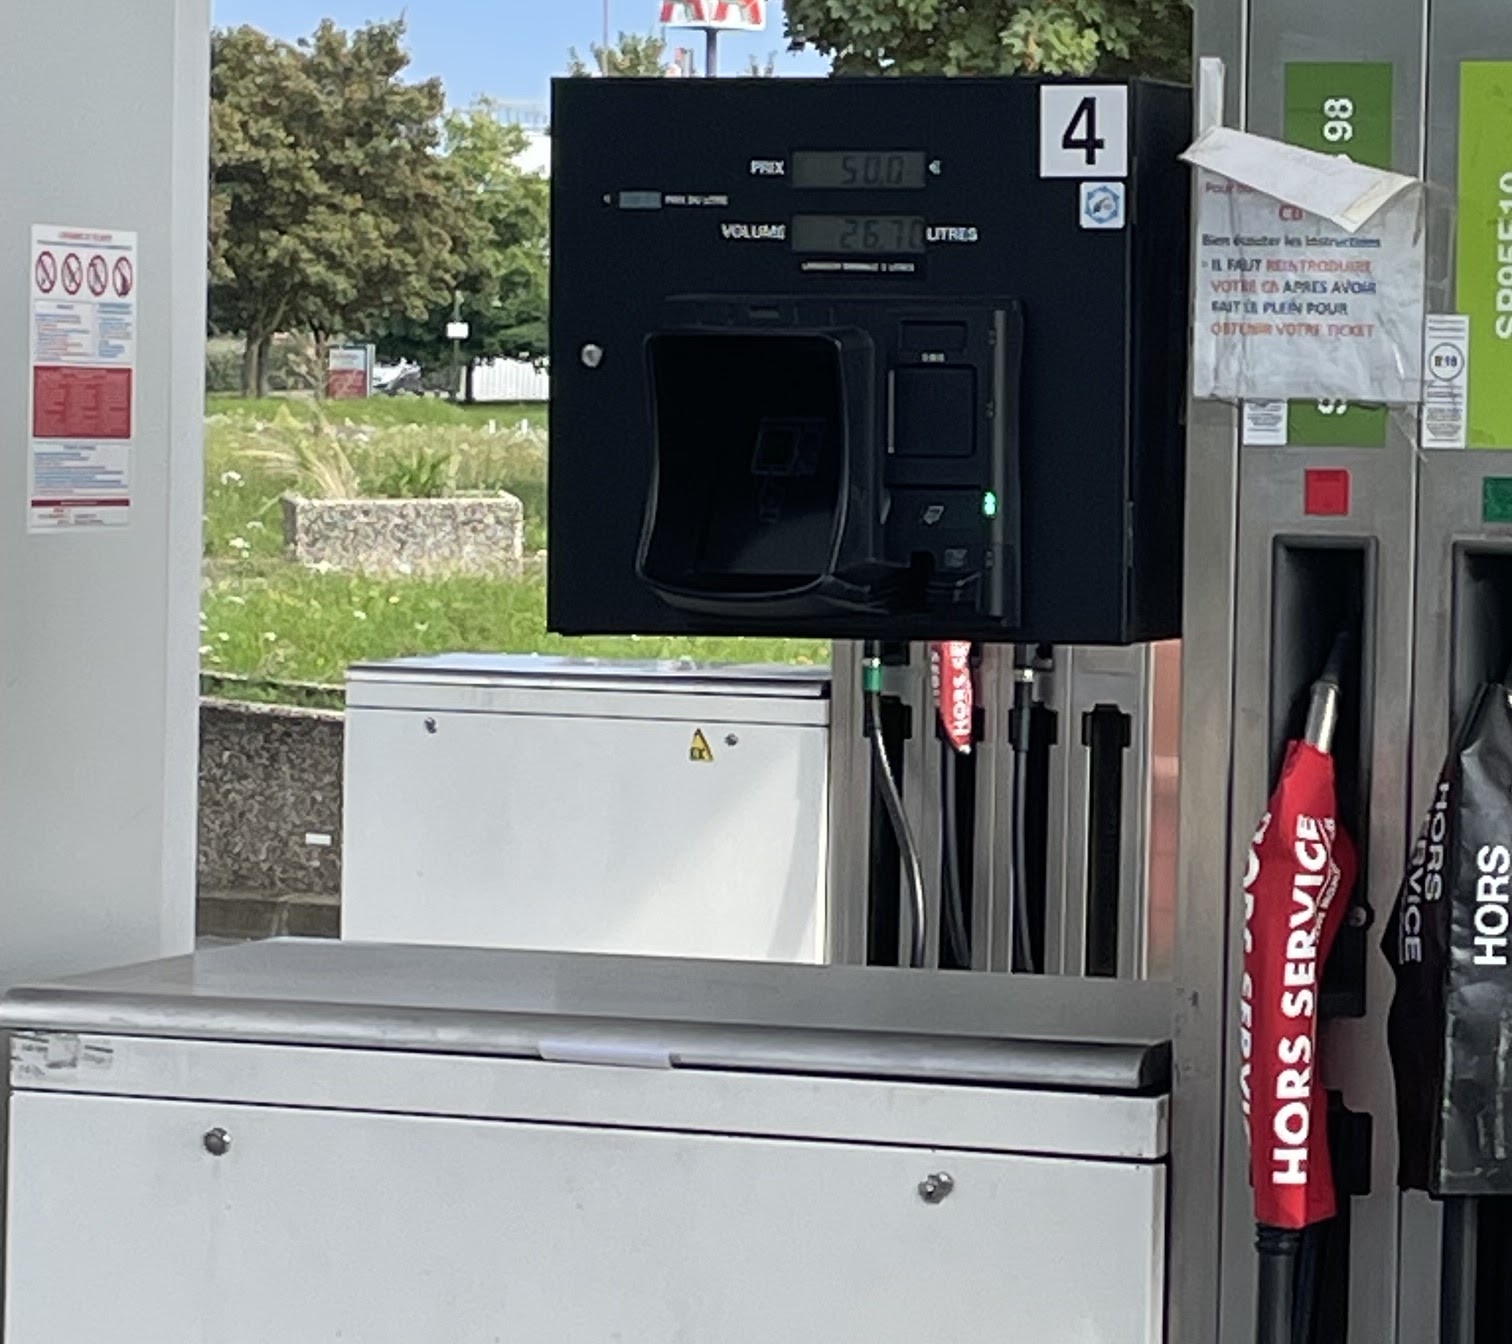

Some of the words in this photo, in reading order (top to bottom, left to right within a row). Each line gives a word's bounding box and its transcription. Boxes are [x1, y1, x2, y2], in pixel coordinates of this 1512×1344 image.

[1323, 97, 1353, 141] 98
[1062, 96, 1105, 166] 4
[750, 160, 785, 175] PRIX
[720, 224, 786, 240] VOLUME
[926, 227, 978, 242] LITRES
[1202, 234, 1230, 246] Bien
[1284, 235, 1302, 246] les
[1211, 260, 1223, 271] IL
[1227, 259, 1262, 271] FAUT
[1266, 260, 1372, 273] REINTRODUIRE
[1211, 280, 1257, 293] VOTRE
[1282, 281, 1327, 293] APRES
[1331, 281, 1377, 294] AVOIR
[1211, 301, 1241, 312] FAIT
[1244, 302, 1258, 314] LE
[1263, 301, 1302, 314] PLEIN
[1306, 302, 1348, 315] POUR
[1211, 323, 1273, 336] OBTENIR
[1276, 323, 1320, 337] VOTRE
[1327, 324, 1374, 337] TICKET
[1425, 782, 1450, 901] HORS
[1474, 845, 1510, 965] HORS
[1281, 814, 1328, 1017] SERVICE
[1273, 1035, 1313, 1185] HORS
